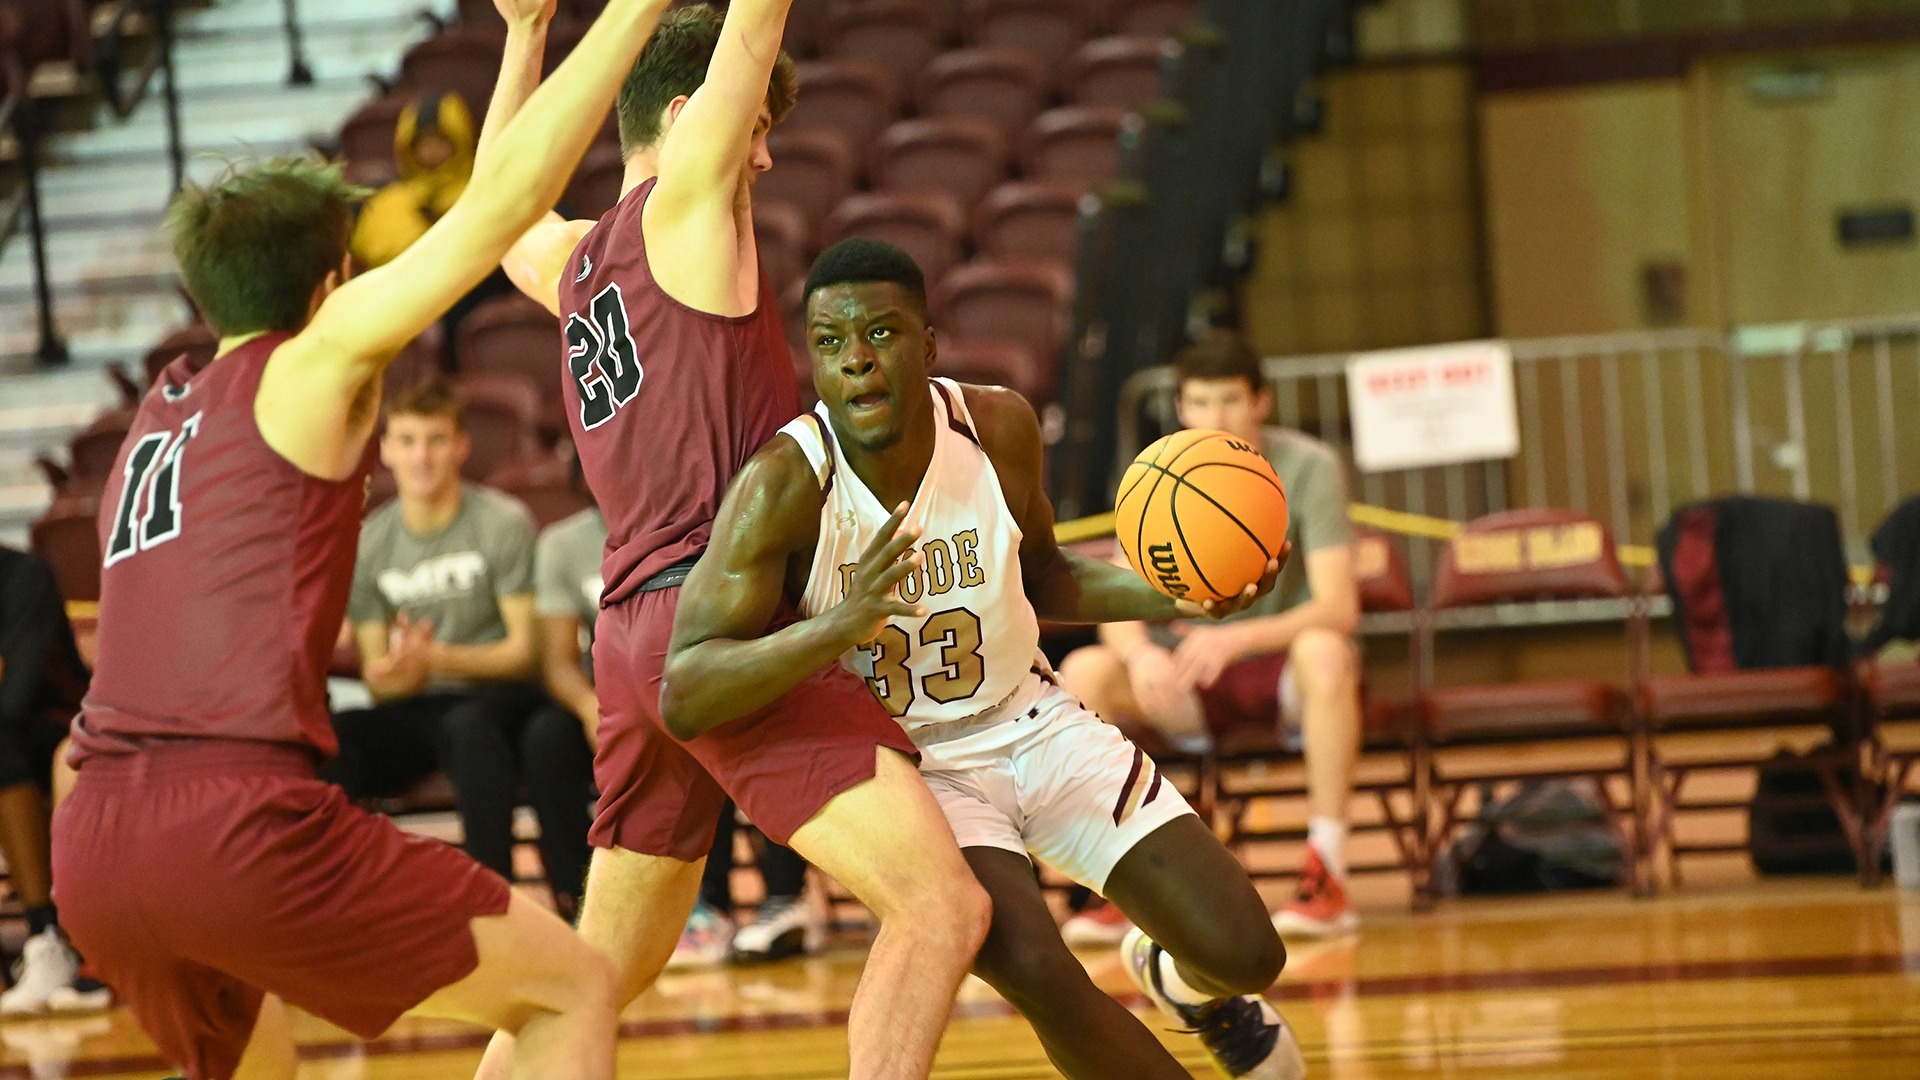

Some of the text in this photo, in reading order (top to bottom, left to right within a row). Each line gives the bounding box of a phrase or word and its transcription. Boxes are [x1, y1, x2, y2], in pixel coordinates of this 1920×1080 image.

[564, 281, 644, 432] 20
[103, 410, 203, 569] 11
[838, 528, 985, 603] ODE
[857, 606, 985, 718] 33
